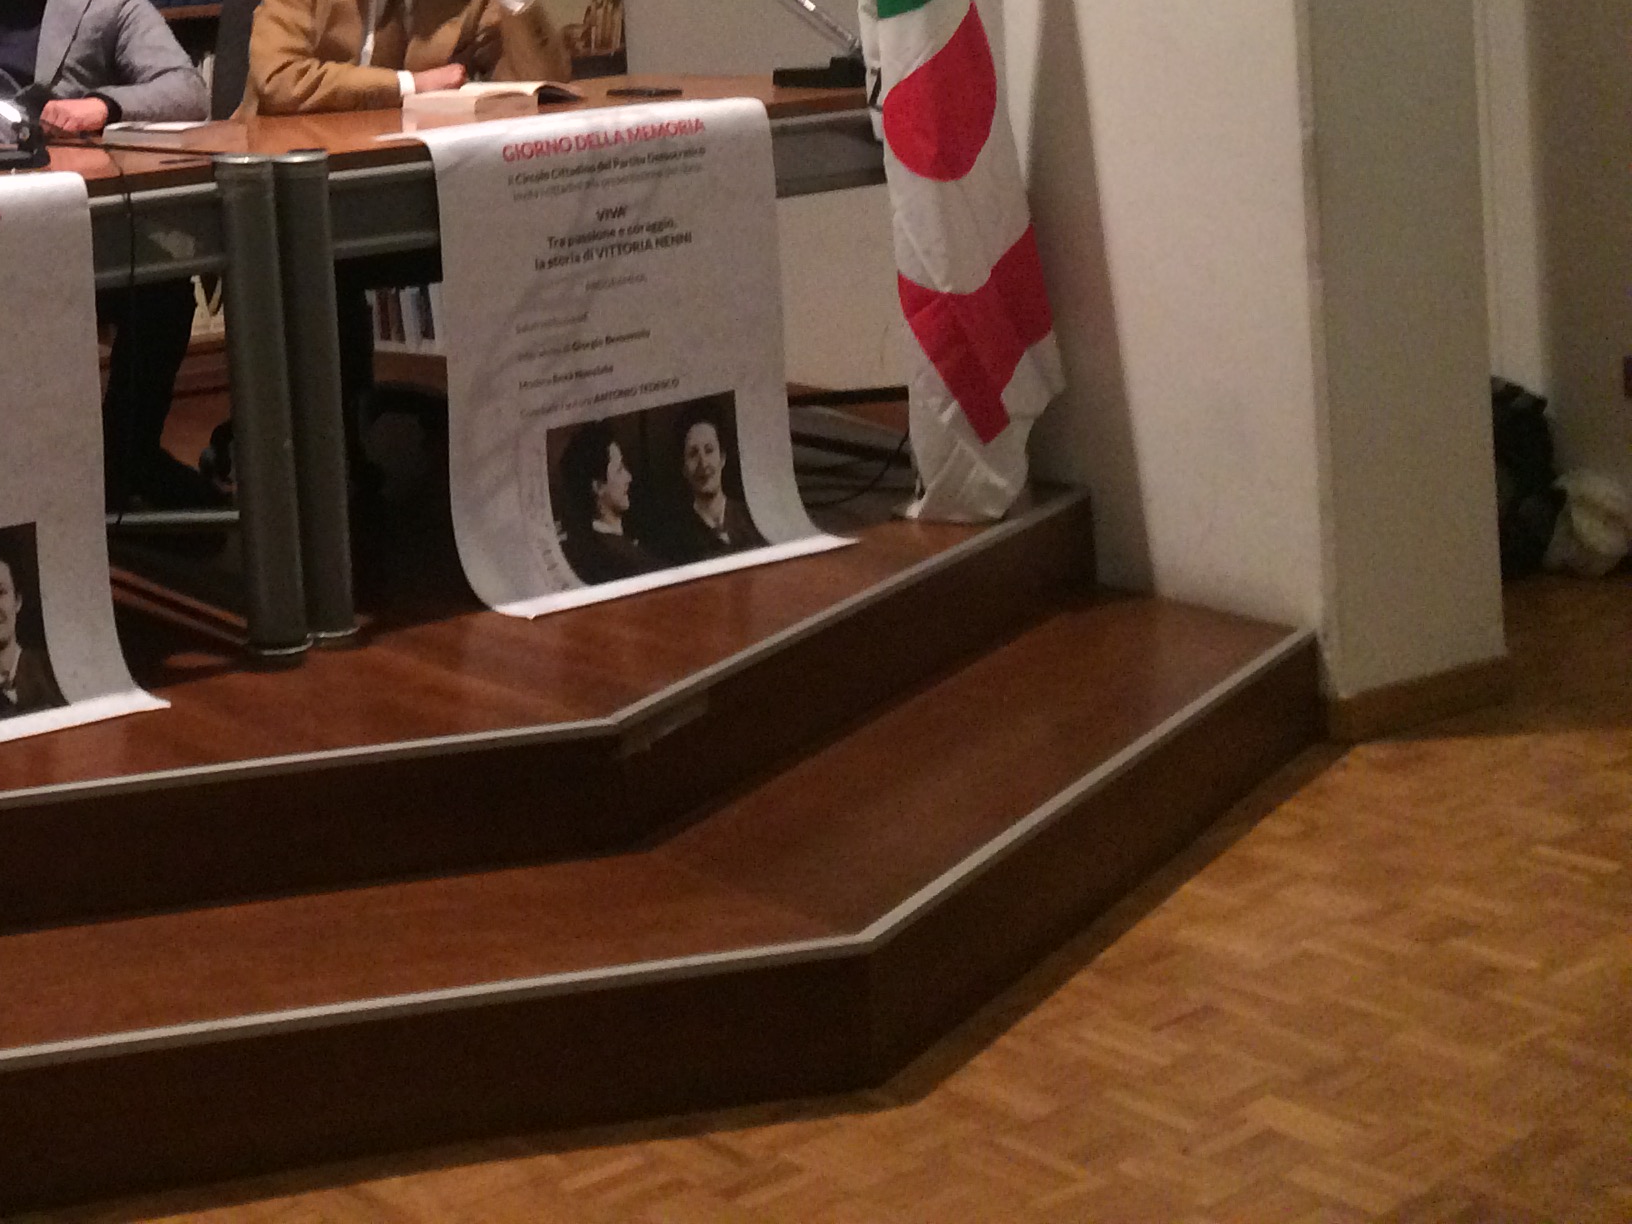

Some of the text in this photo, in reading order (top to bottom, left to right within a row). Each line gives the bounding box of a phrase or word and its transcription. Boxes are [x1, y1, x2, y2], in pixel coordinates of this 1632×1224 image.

[502, 118, 706, 163] GIORNO DELLA MEMORIA
[534, 231, 692, 271] la storia di VITTORIA NENNI
